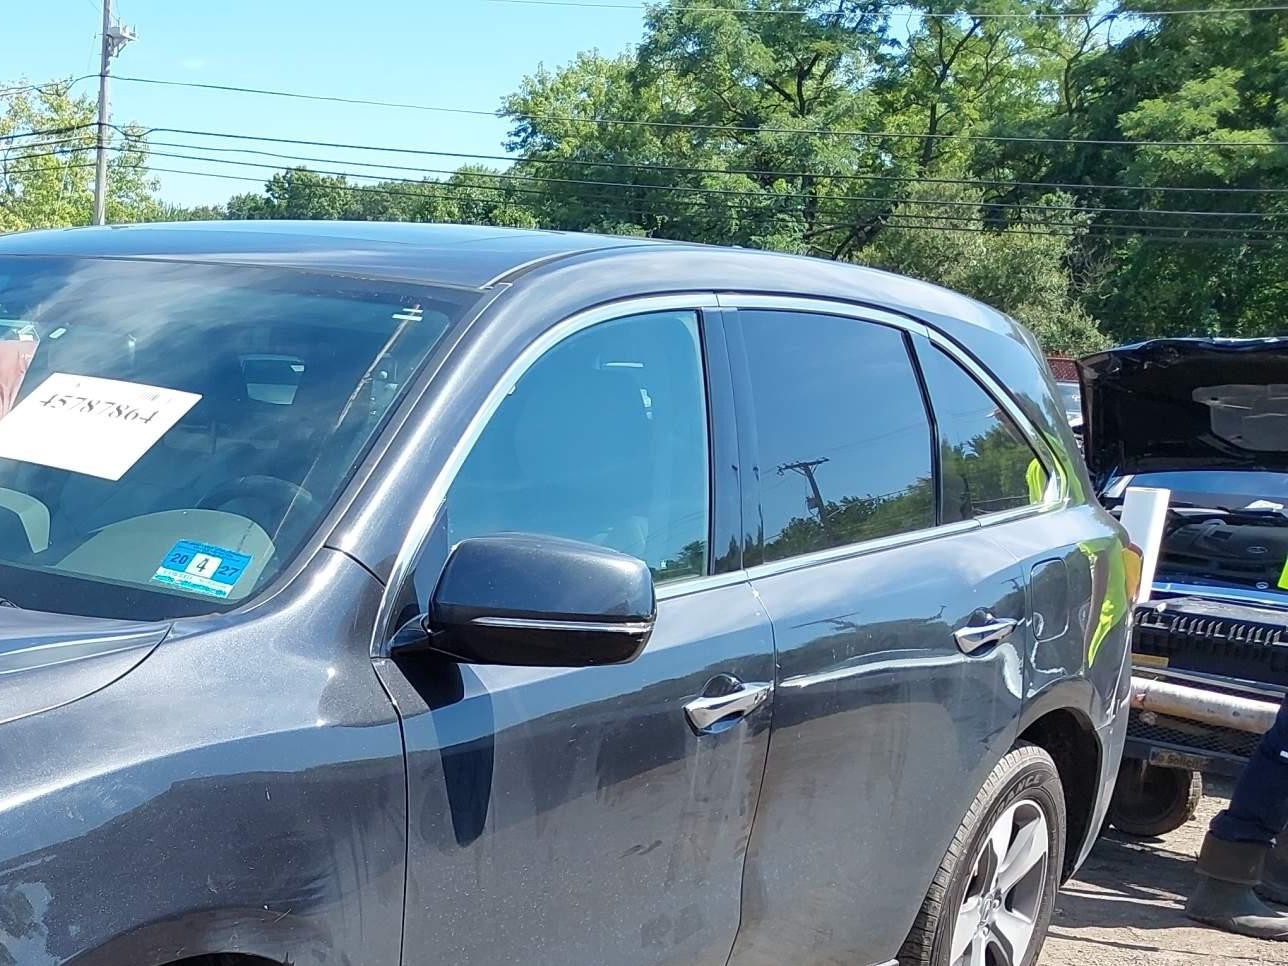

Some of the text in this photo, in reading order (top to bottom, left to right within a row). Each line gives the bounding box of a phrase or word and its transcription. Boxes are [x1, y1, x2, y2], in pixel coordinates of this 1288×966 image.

[39, 393, 160, 425] 45787864
[169, 552, 189, 565] 20
[196, 557, 210, 573] 4
[218, 565, 241, 578] 27
